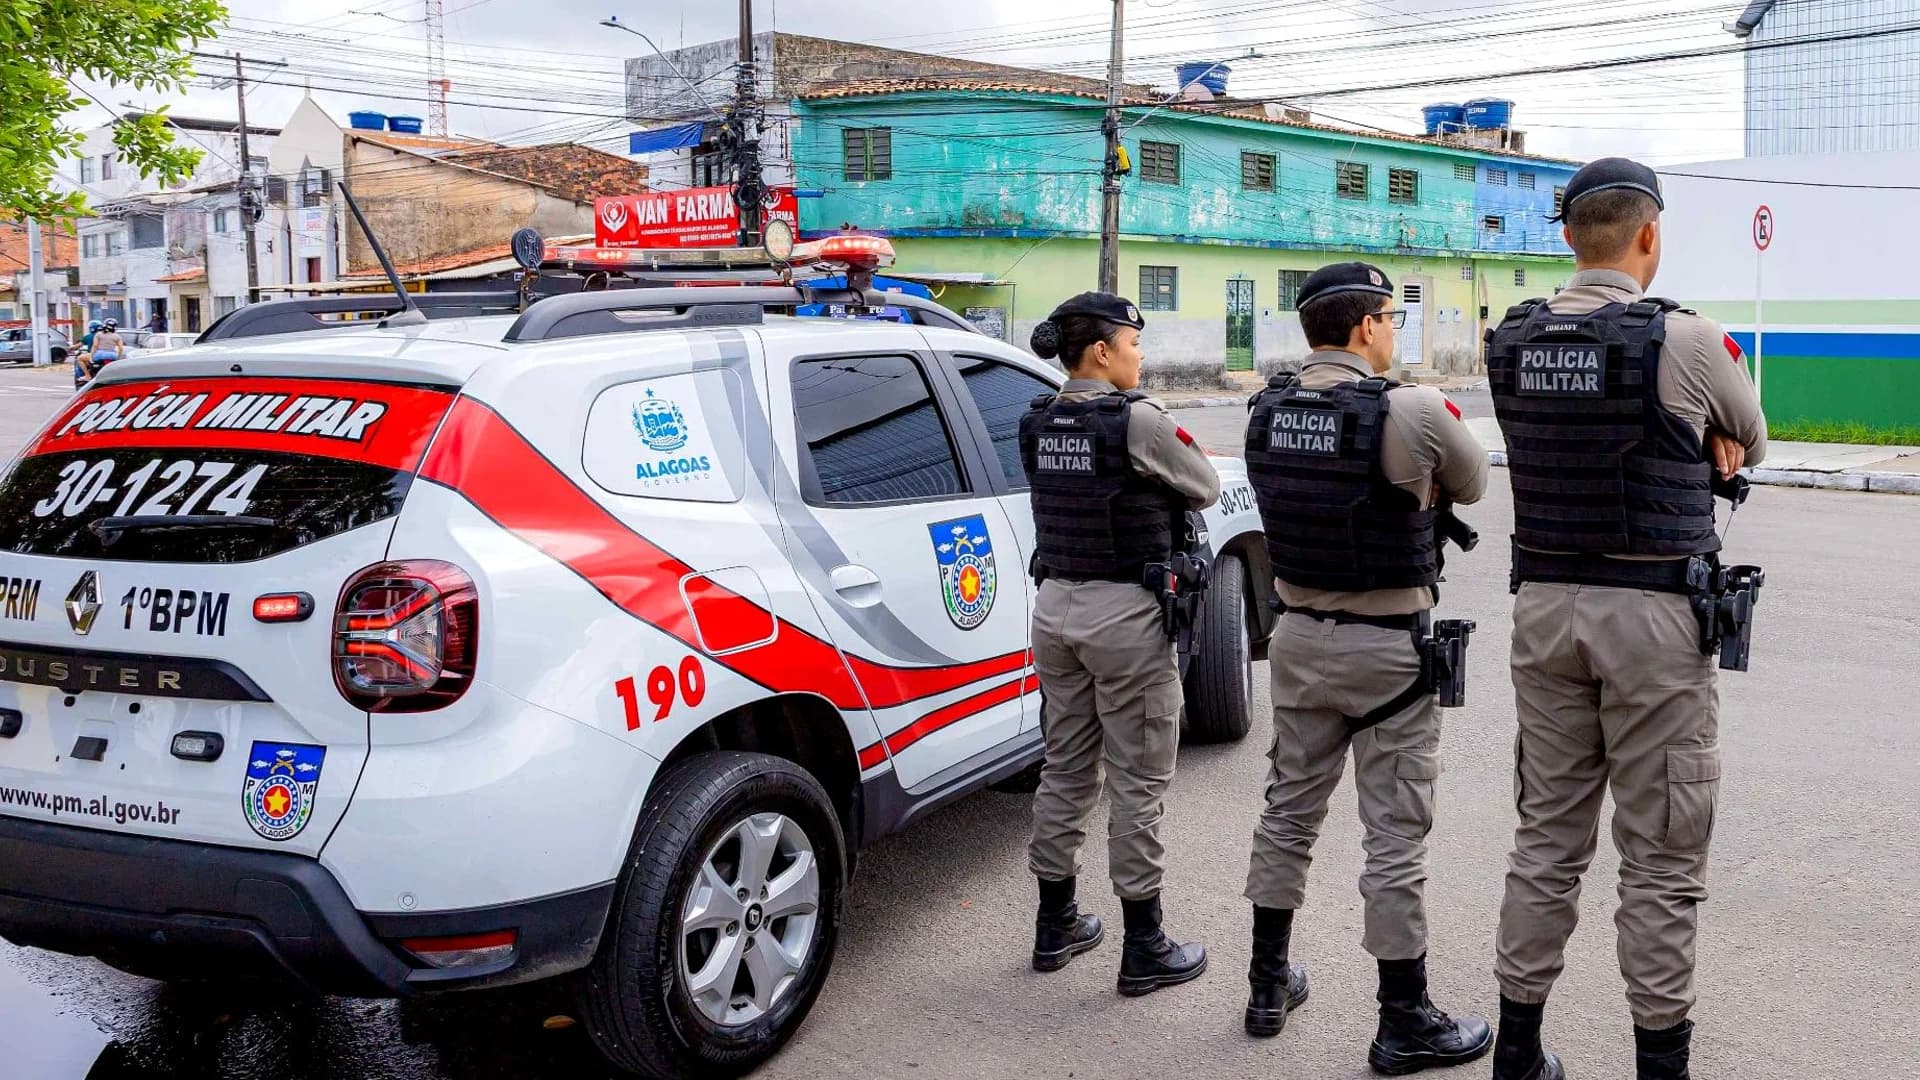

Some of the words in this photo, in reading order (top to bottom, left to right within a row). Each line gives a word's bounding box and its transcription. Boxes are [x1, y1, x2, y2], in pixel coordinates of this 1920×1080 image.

[636, 199, 668, 225] VAN
[676, 191, 735, 223] FARMA
[1520, 347, 1599, 369] POLÍCIA
[1520, 372, 1600, 392] MILITAR
[56, 386, 210, 437] POLÍCIA
[196, 392, 388, 441] MILITAR
[1272, 411, 1337, 432] POLÍCIA
[1038, 435, 1091, 453] POLÍCIA
[1271, 432, 1336, 452] MILITAR
[636, 456, 711, 480] ALAGOAS
[1038, 455, 1092, 471] MILITAR
[34, 458, 269, 518] 30-1274
[644, 473, 711, 488] GOVERNO
[614, 654, 706, 732] 190
[247, 780, 255, 790] P
[302, 784, 313, 794] M
[0, 786, 181, 825] www.pm.al.gov.br
[258, 825, 295, 838] ALAGOAS
